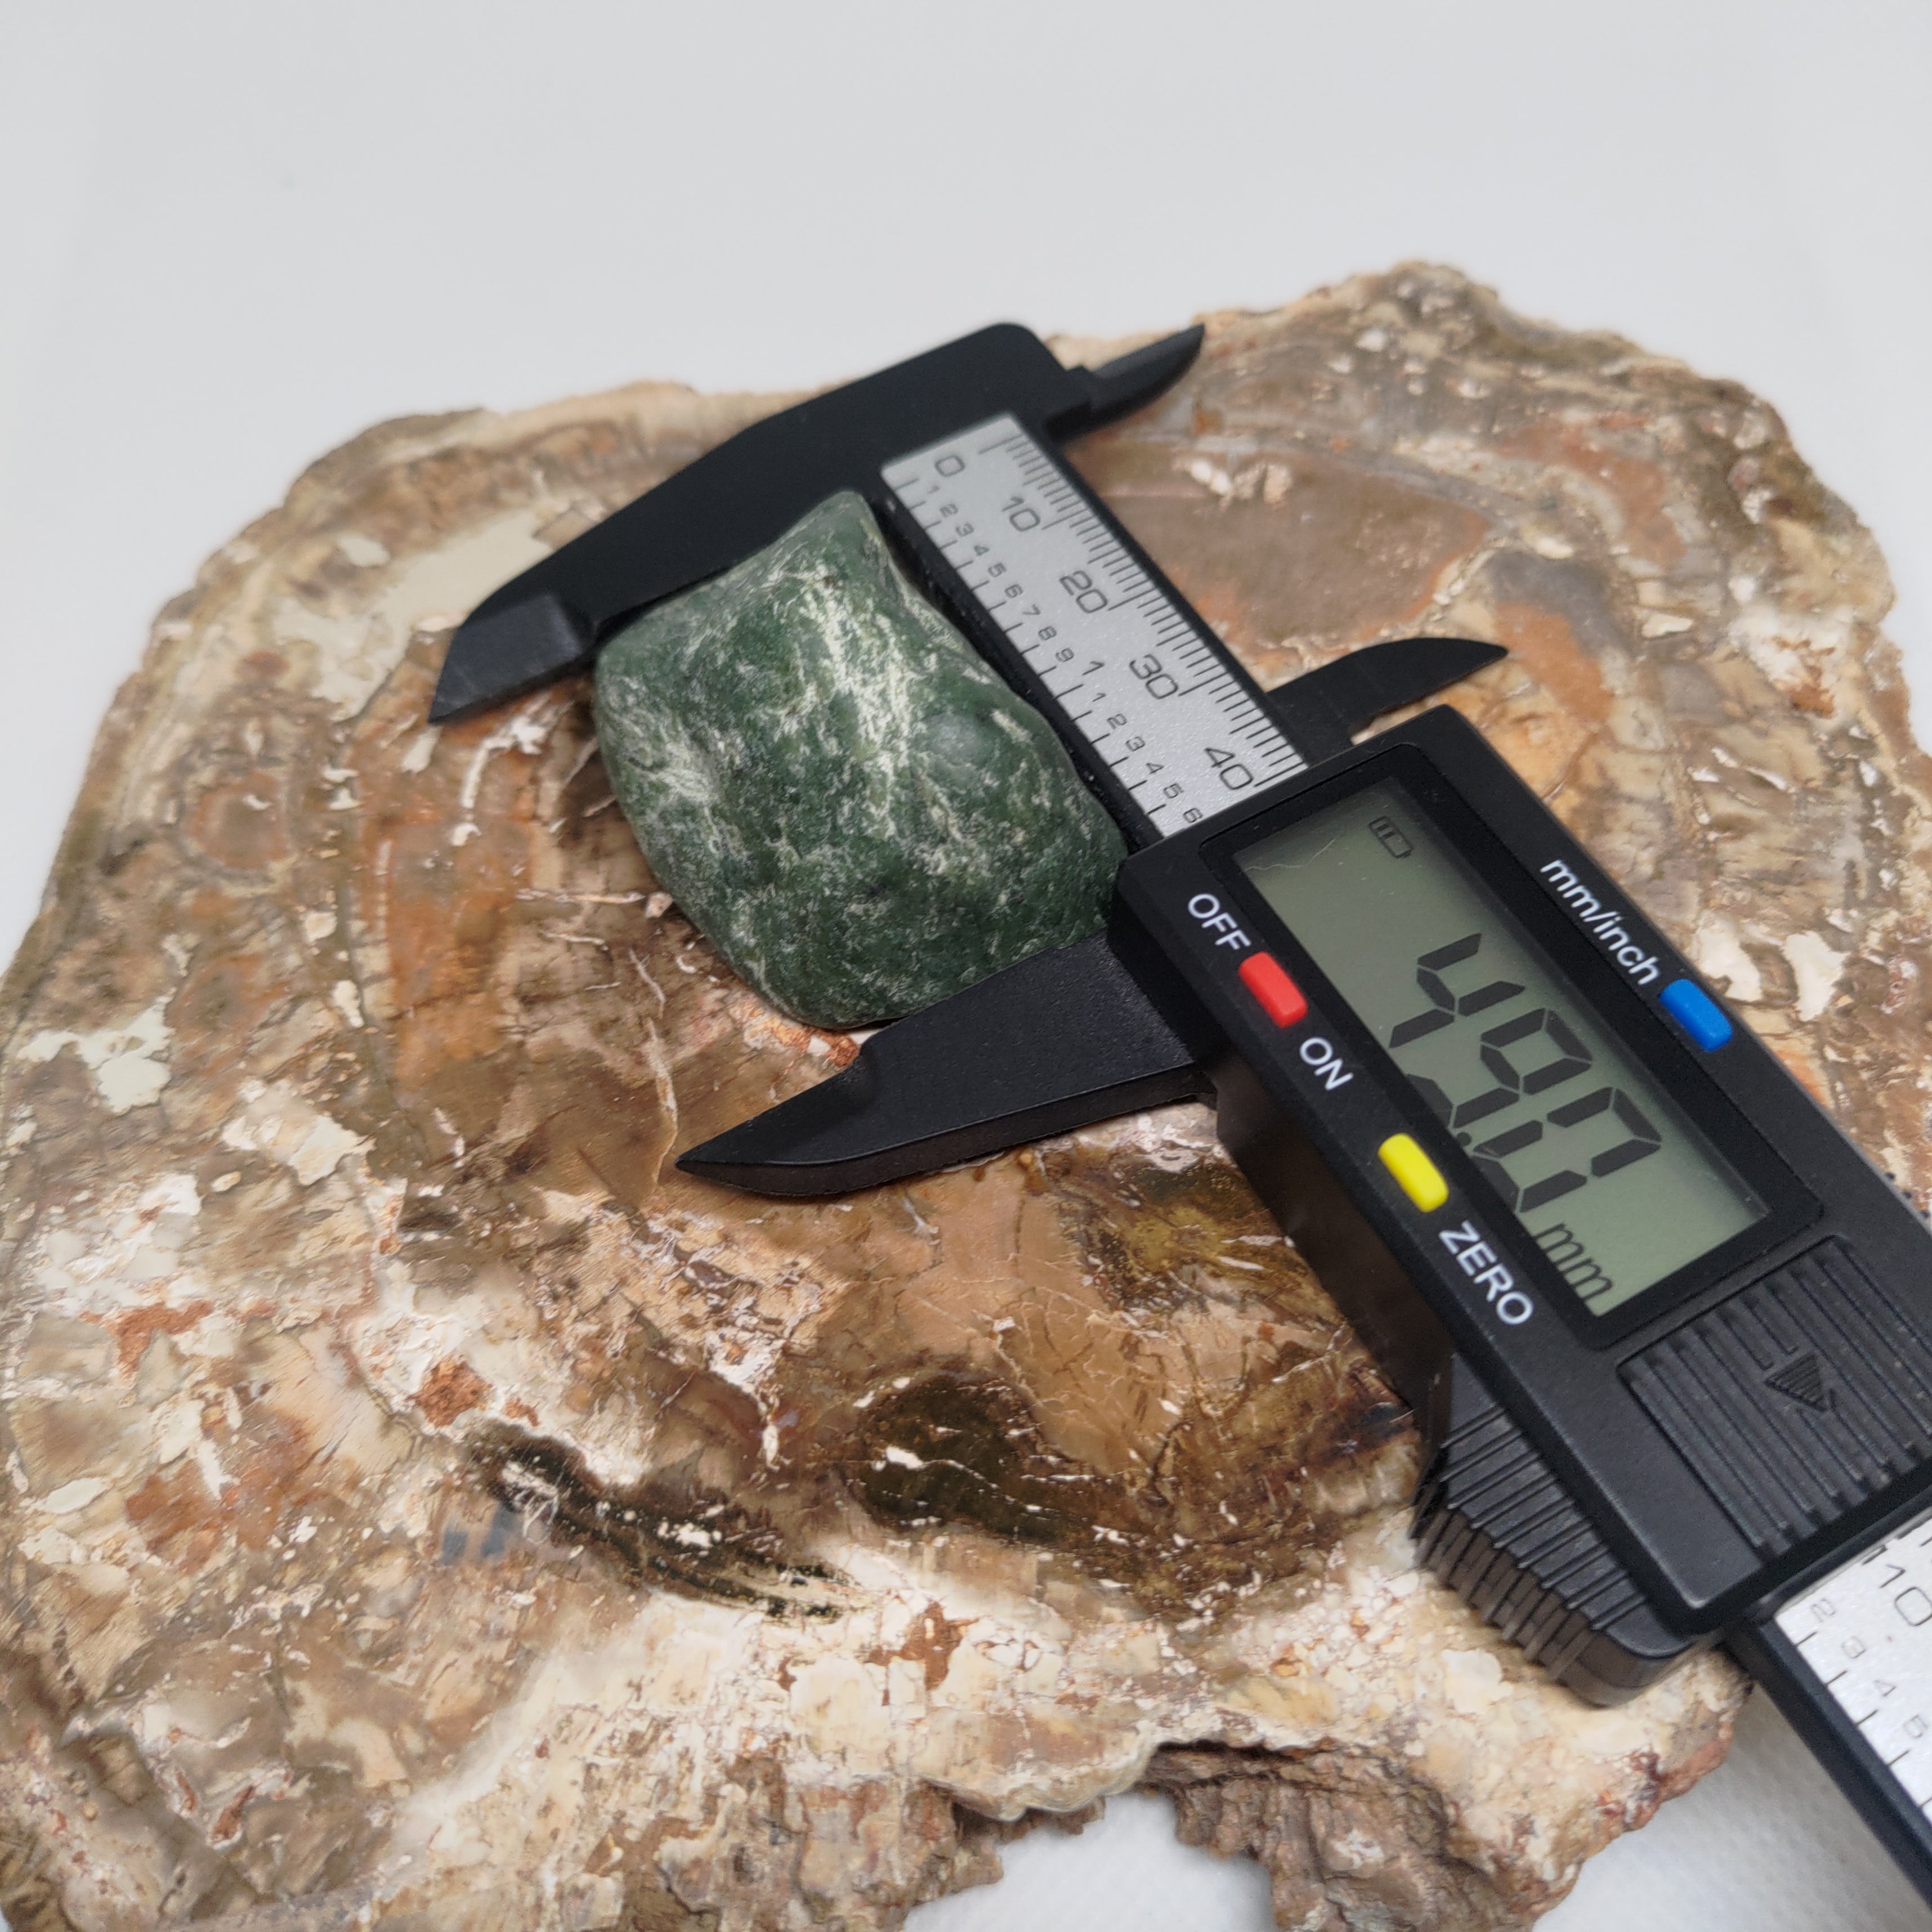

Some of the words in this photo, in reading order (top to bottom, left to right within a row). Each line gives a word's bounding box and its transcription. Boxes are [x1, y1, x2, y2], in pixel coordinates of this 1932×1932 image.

[940, 503, 958, 518] 2
[956, 522, 974, 538] 3
[973, 544, 990, 557] 4
[987, 563, 1007, 578] 5
[1004, 584, 1023, 598] 6
[1022, 603, 1040, 616] 7
[934, 455, 965, 477] 0
[1001, 496, 1040, 532] 10
[1059, 570, 1108, 614] 20
[1129, 654, 1179, 700] 30
[1204, 747, 1254, 790] 40
[1038, 626, 1057, 641] 8
[1055, 647, 1074, 663] 9
[1081, 660, 1105, 676] 1
[1092, 692, 1107, 703] 1
[1107, 713, 1127, 730] 2
[1125, 736, 1146, 752] 3
[1146, 762, 1164, 775] 4
[1163, 783, 1184, 799] 5
[1183, 807, 1204, 824] 6
[1187, 893, 1251, 950] OFF
[1540, 859, 1660, 985] mm/inch
[1299, 1037, 1354, 1091] ON
[1533, 1223, 1613, 1302] mm
[1439, 1220, 1534, 1325] ZERO
